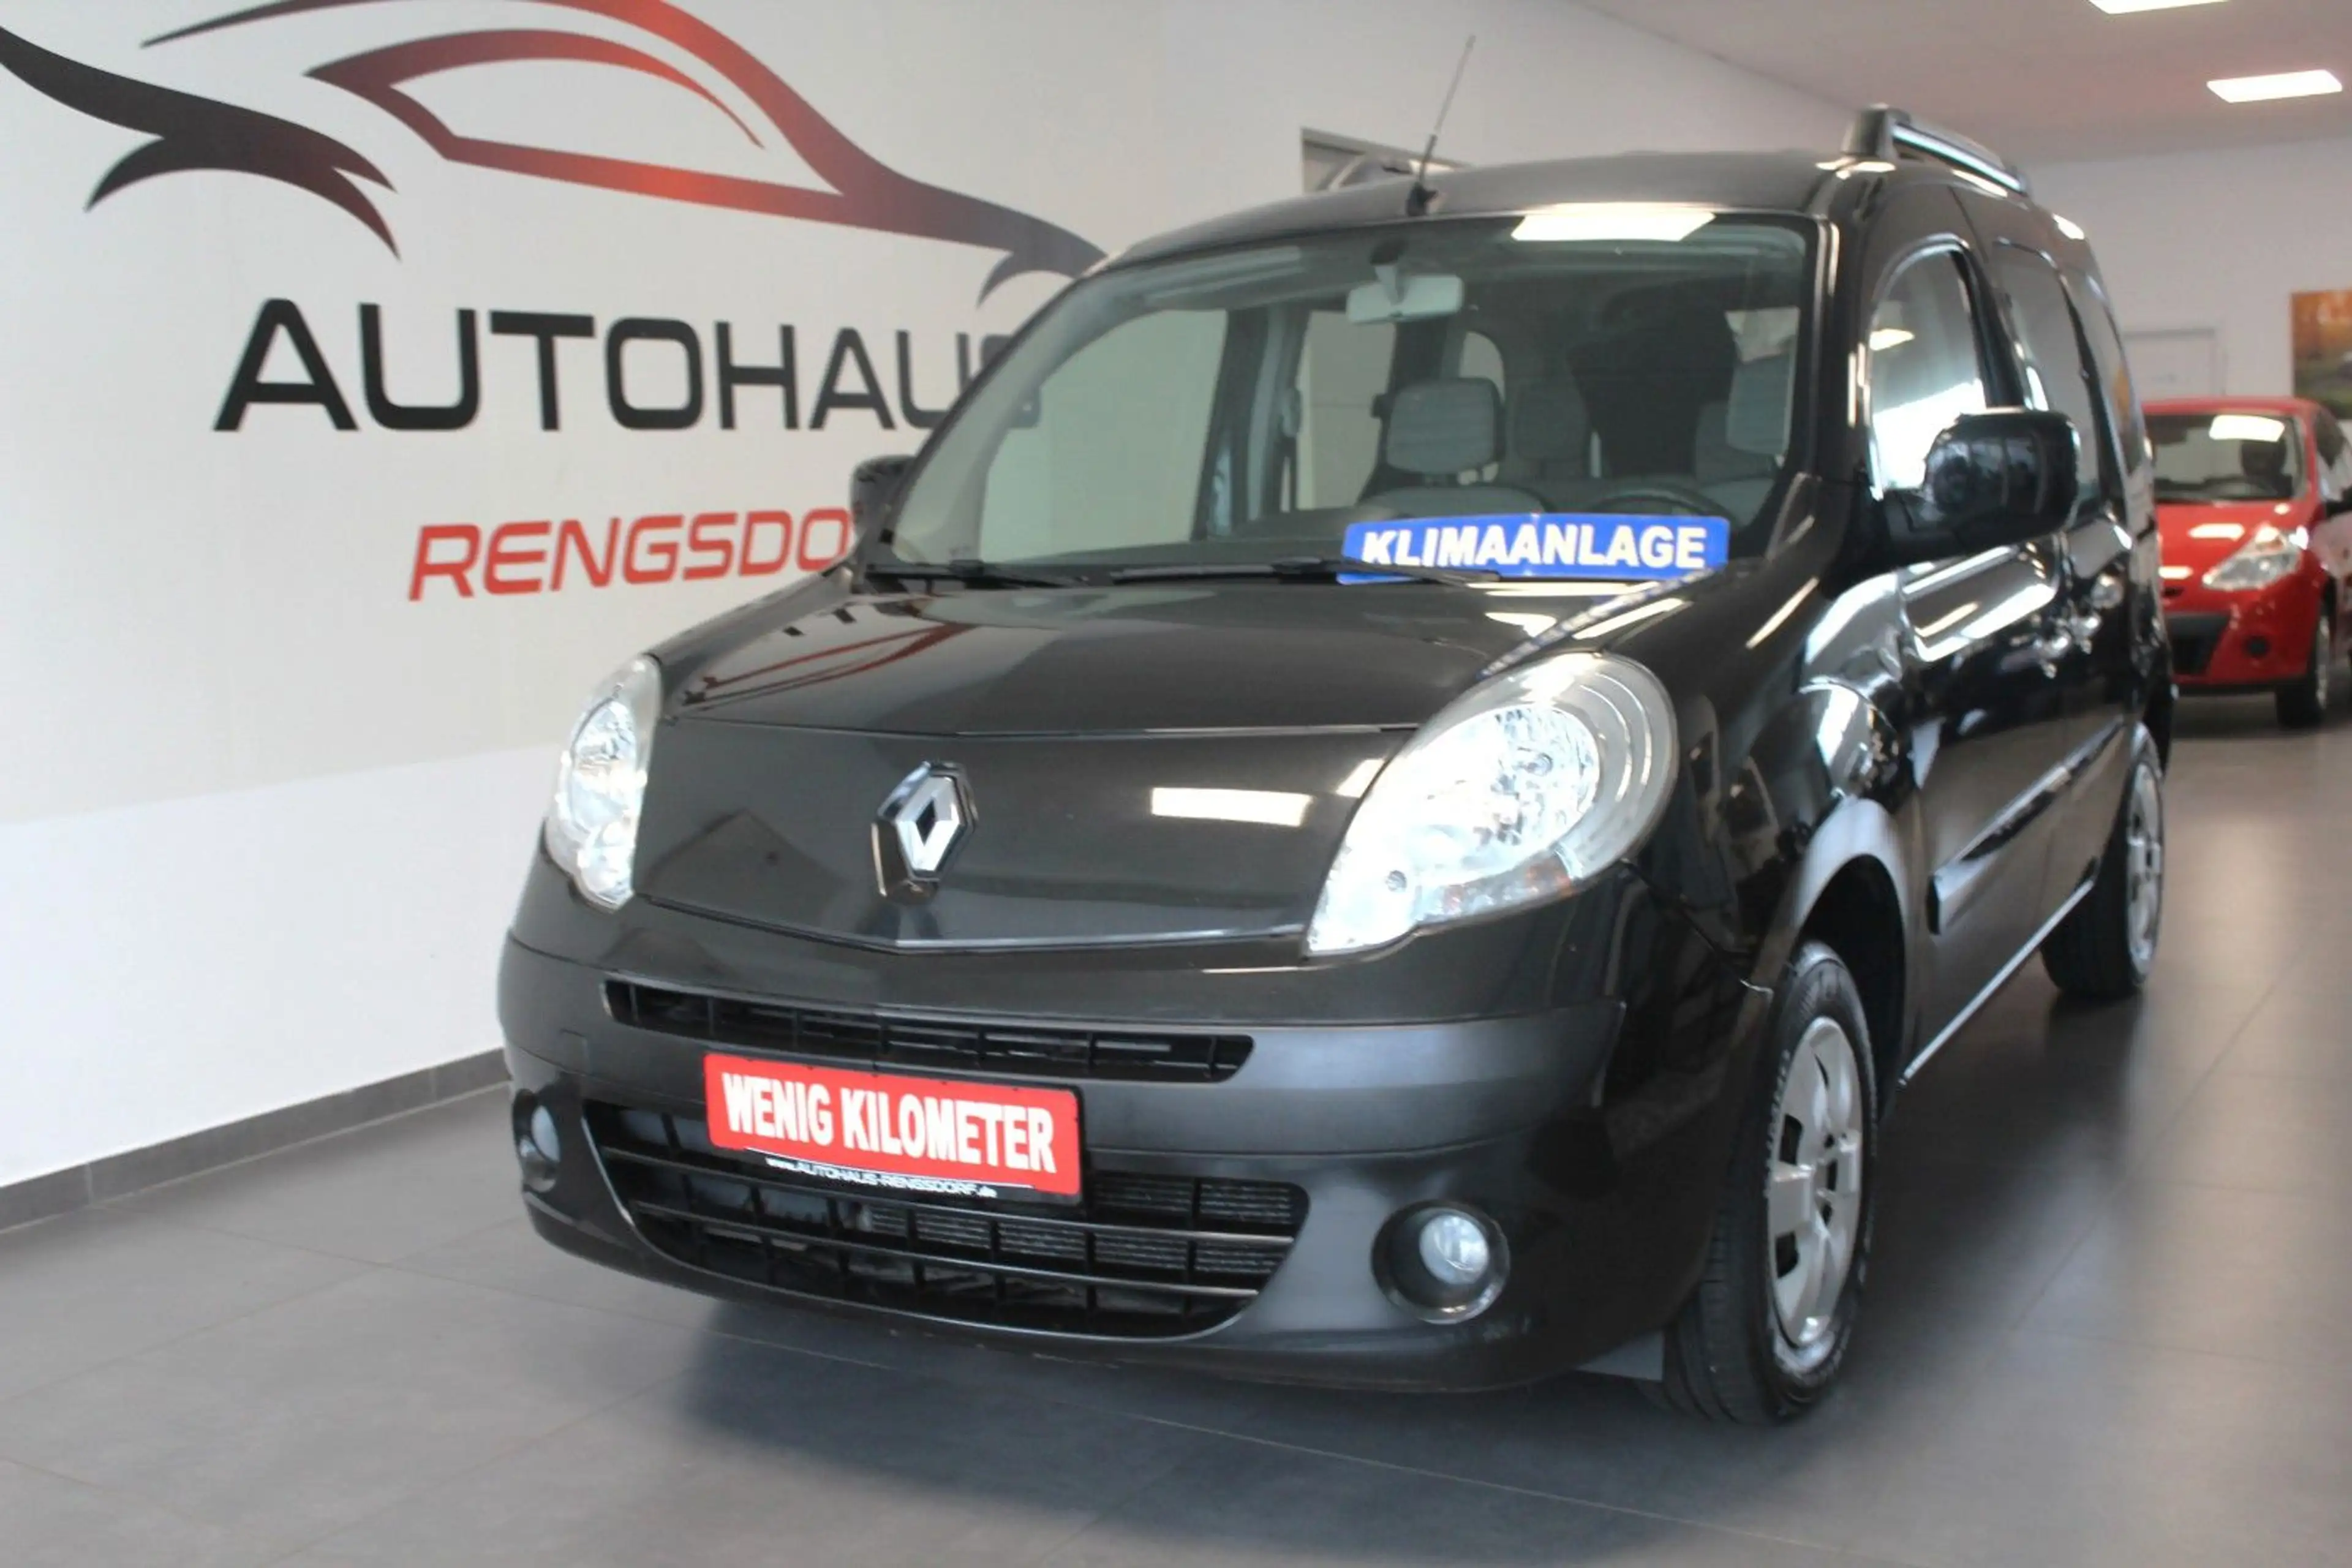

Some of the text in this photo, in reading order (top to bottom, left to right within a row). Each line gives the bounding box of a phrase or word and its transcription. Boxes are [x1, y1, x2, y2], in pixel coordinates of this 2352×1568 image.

[1362, 523, 1706, 570] KLIMAANLAGE
[722, 1072, 1057, 1174] WENIG KILOMETER
